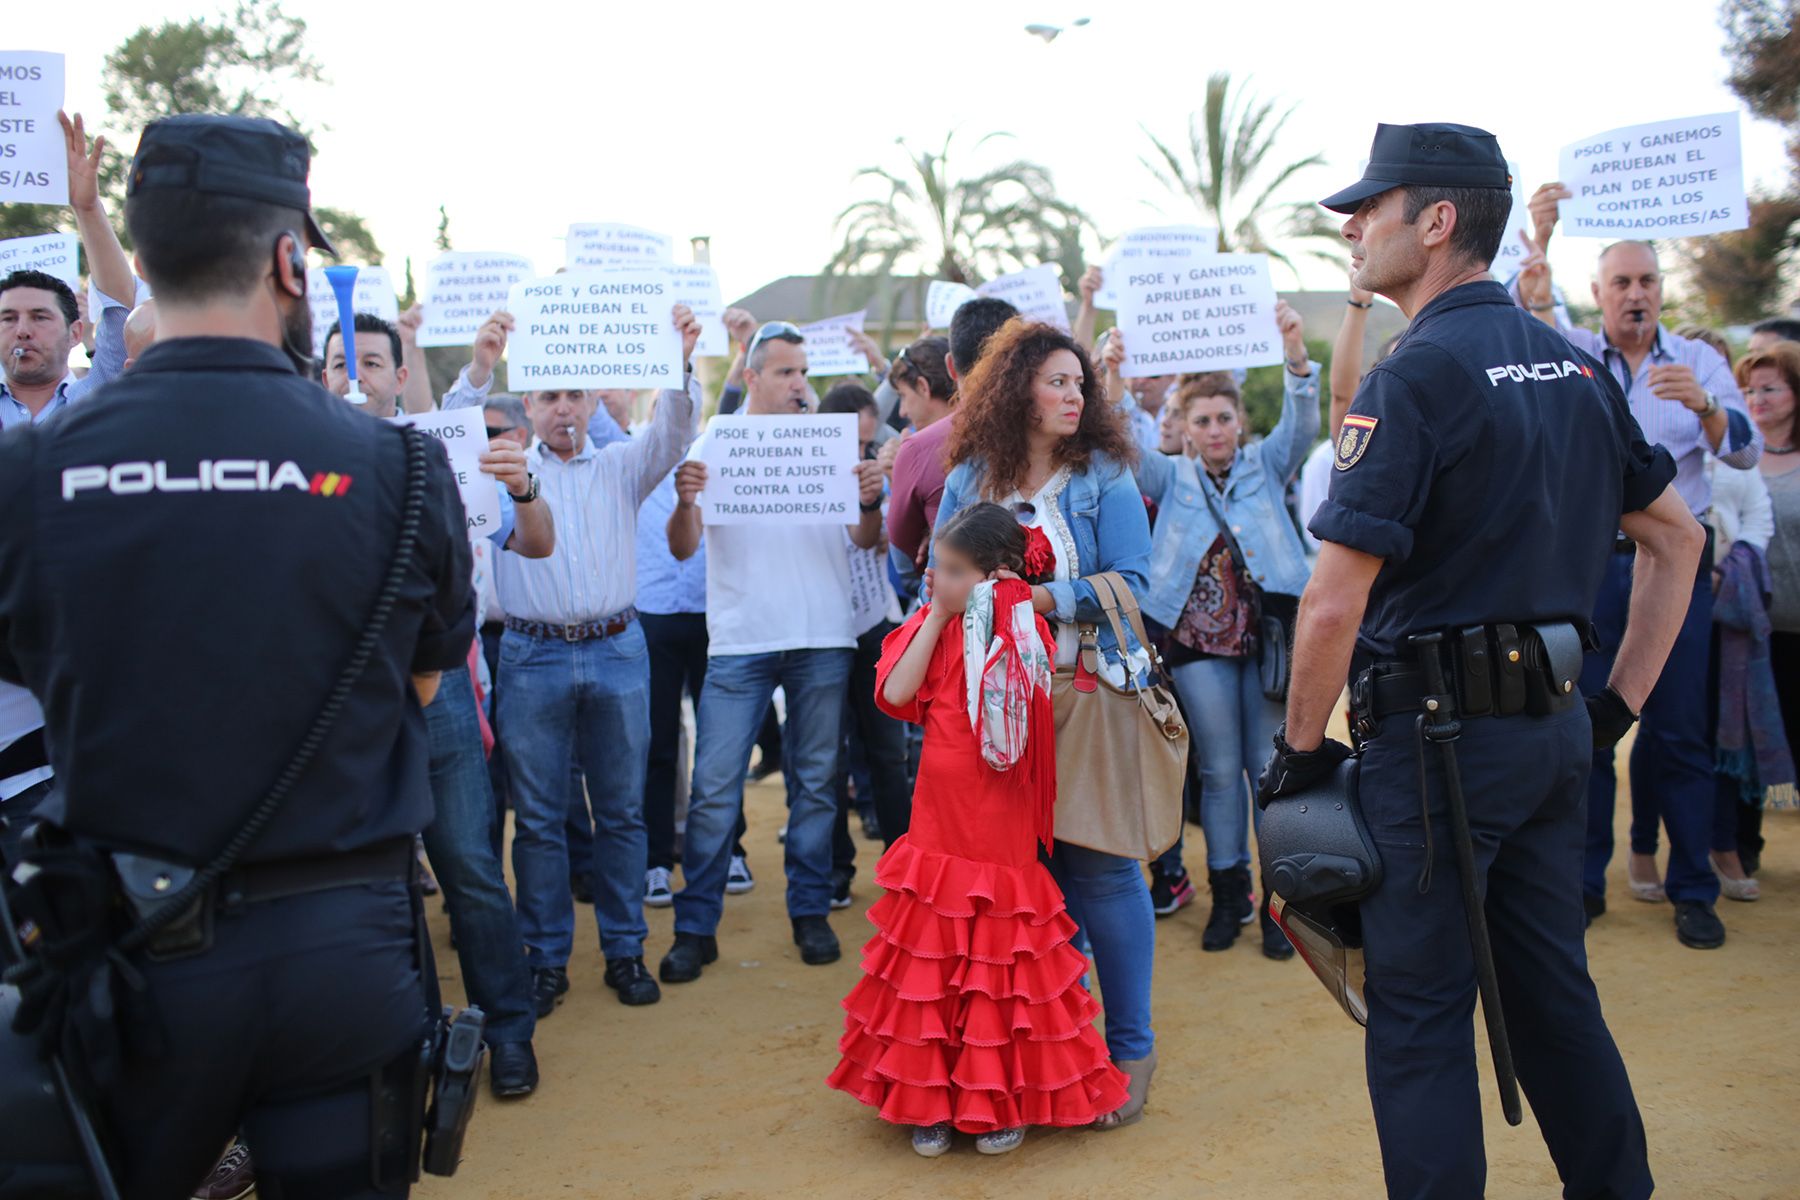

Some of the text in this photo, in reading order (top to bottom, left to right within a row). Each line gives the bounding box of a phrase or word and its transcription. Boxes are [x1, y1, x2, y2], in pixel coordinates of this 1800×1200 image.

[0, 119, 35, 134] STE
[1574, 125, 1722, 159] PSOE y GANEMOS
[1591, 149, 1705, 175] APRUEBAN EL
[1582, 169, 1718, 197] PLAN DE AJUSTE
[1597, 191, 1703, 212] CONTRA LOS
[1576, 207, 1730, 228] TRABAJADORES/AS
[0, 248, 18, 260] GT
[438, 274, 520, 286] APRUEBAN EL
[1129, 265, 1257, 286] PSOE y GANEMOS
[433, 291, 508, 304] PLAN DE AJU
[525, 284, 664, 298] PSOE y GANEMOS
[1145, 284, 1246, 305] APRUEBAN EL
[444, 308, 490, 319] CONTRA
[541, 303, 648, 315] APRUEBAN EL
[1137, 303, 1257, 326] PLAN DE AJUSTE
[531, 324, 659, 335] PLAN DE AJUSTE
[1152, 324, 1245, 343] CONTRA LOS
[545, 343, 646, 355] CONTRA LOS
[1132, 342, 1270, 365] TRABAJADORES/AS
[522, 364, 670, 377] TRABAJADORES/AS
[715, 427, 841, 441] PSOE y GANEMOS
[729, 446, 827, 458] APRUEBAN EL
[721, 465, 837, 477] PLAN DE AJUSTE
[62, 460, 310, 500] POLICIA
[734, 484, 824, 495] CONTRA LOS
[715, 503, 846, 515] TRABAJADORES/AS
